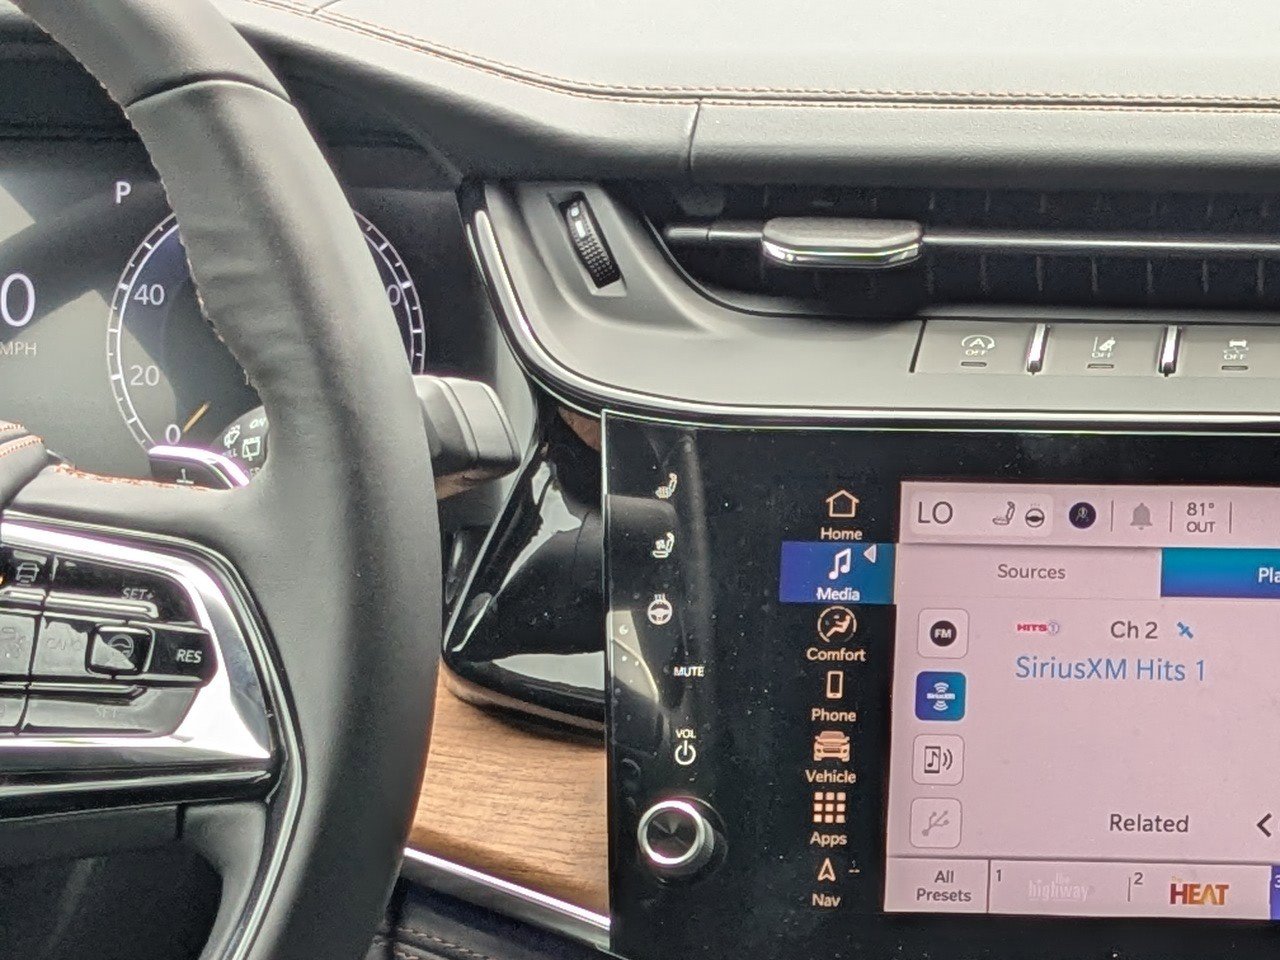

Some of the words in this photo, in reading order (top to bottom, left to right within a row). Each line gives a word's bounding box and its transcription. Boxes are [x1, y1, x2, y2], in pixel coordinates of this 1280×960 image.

[116, 182, 131, 203] P
[1, 273, 36, 327] 0
[134, 284, 165, 305] 40
[0, 341, 37, 356] MPH
[131, 366, 160, 386] 20
[165, 424, 181, 445] 0
[917, 501, 954, 525] LO
[1186, 502, 1215, 518] 81°
[820, 527, 863, 541] Home
[1186, 521, 1216, 534] OUT
[997, 563, 1066, 581] Sources
[816, 587, 860, 601] Media
[934, 629, 952, 639] FM
[1017, 624, 1047, 632] HITS
[1110, 621, 1139, 639] Ch
[1145, 622, 1158, 639] 2
[176, 650, 202, 663] RES
[806, 647, 866, 662] Comfort
[674, 666, 704, 677] MUTE
[1016, 656, 1127, 679] SiriusXM
[1137, 658, 1186, 681] Hits
[1196, 660, 1205, 681] 1
[811, 707, 856, 723] Phone
[675, 728, 696, 739] VOL
[805, 769, 857, 784] Vehicle
[1110, 814, 1189, 834] Related
[810, 831, 848, 848] Apps
[934, 869, 954, 884] All
[996, 870, 1002, 882] 1
[1134, 873, 1143, 885] 2
[812, 893, 841, 907] Nav
[916, 888, 972, 903] Presets
[1170, 883, 1229, 906] HEAT
